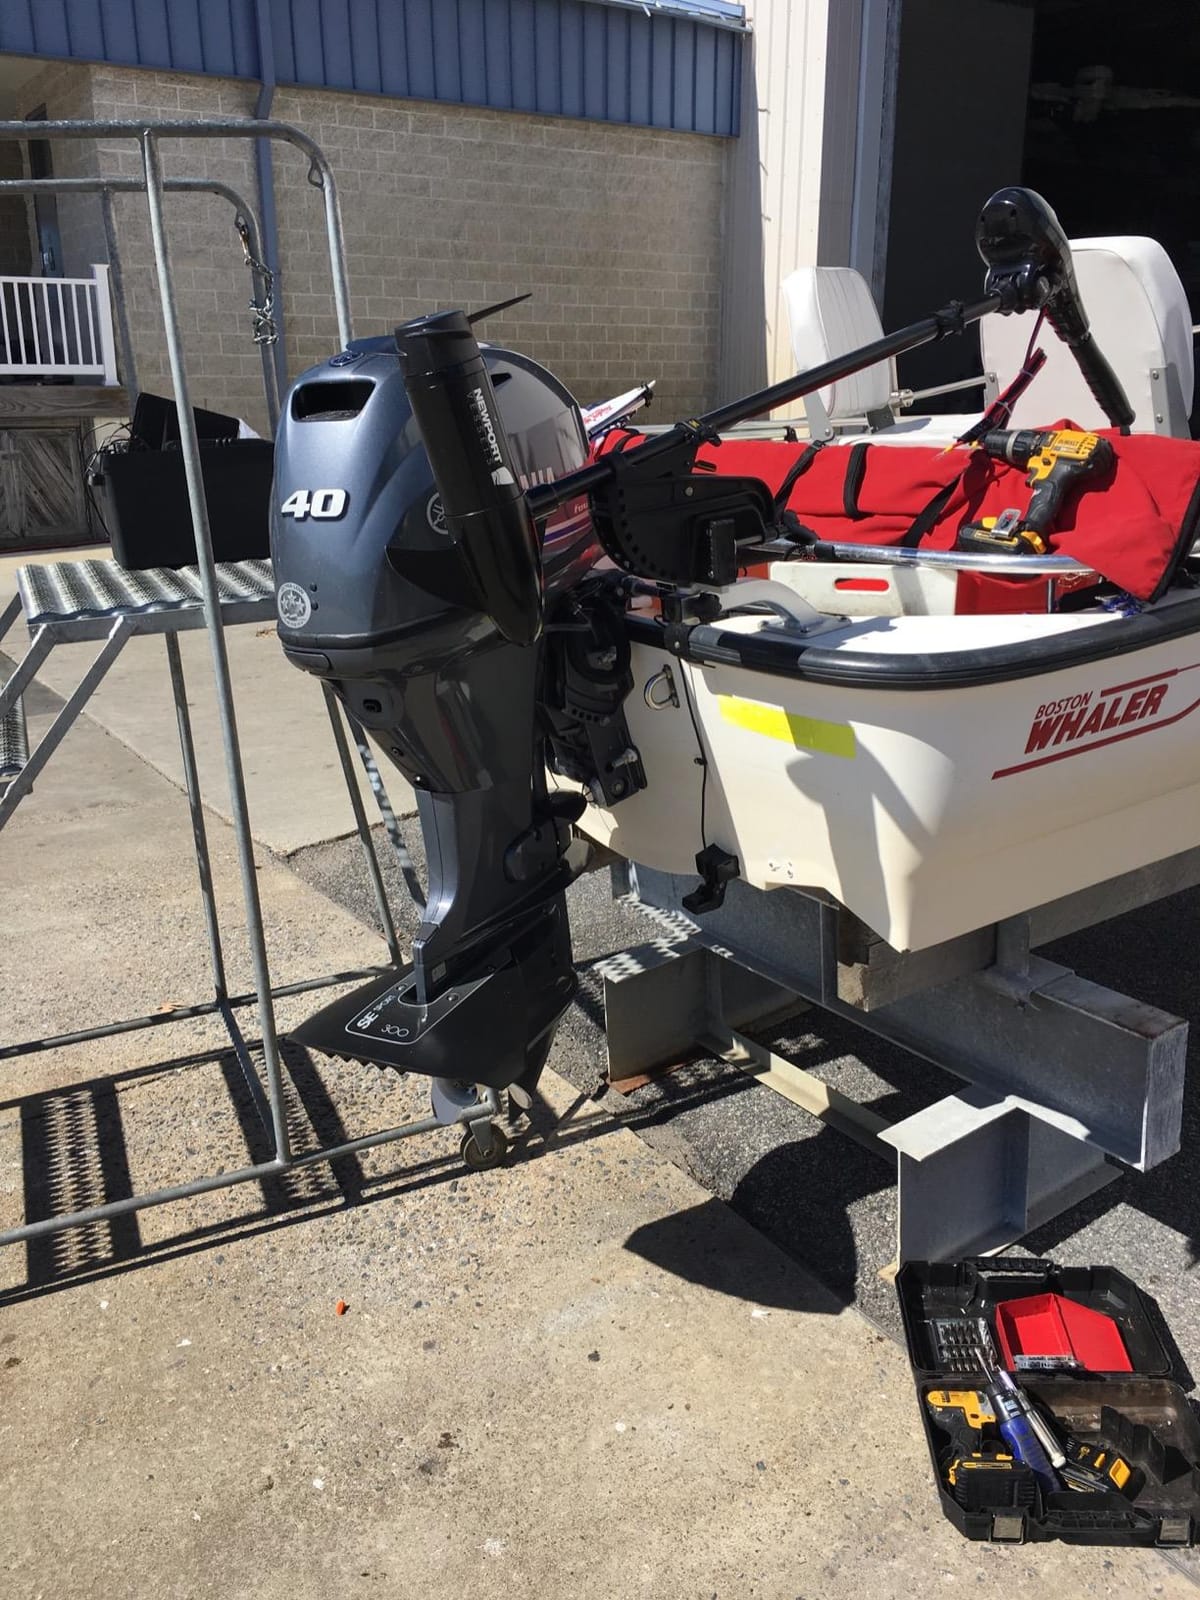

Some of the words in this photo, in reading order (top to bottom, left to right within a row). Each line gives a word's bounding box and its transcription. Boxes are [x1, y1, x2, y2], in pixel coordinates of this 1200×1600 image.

[473, 387, 503, 463] NEWPORT
[281, 489, 348, 520] 40
[1024, 683, 1169, 754] WHALER
[1034, 690, 1094, 720] BOSTON
[356, 1011, 379, 1030] SE
[381, 1024, 410, 1038] 300
